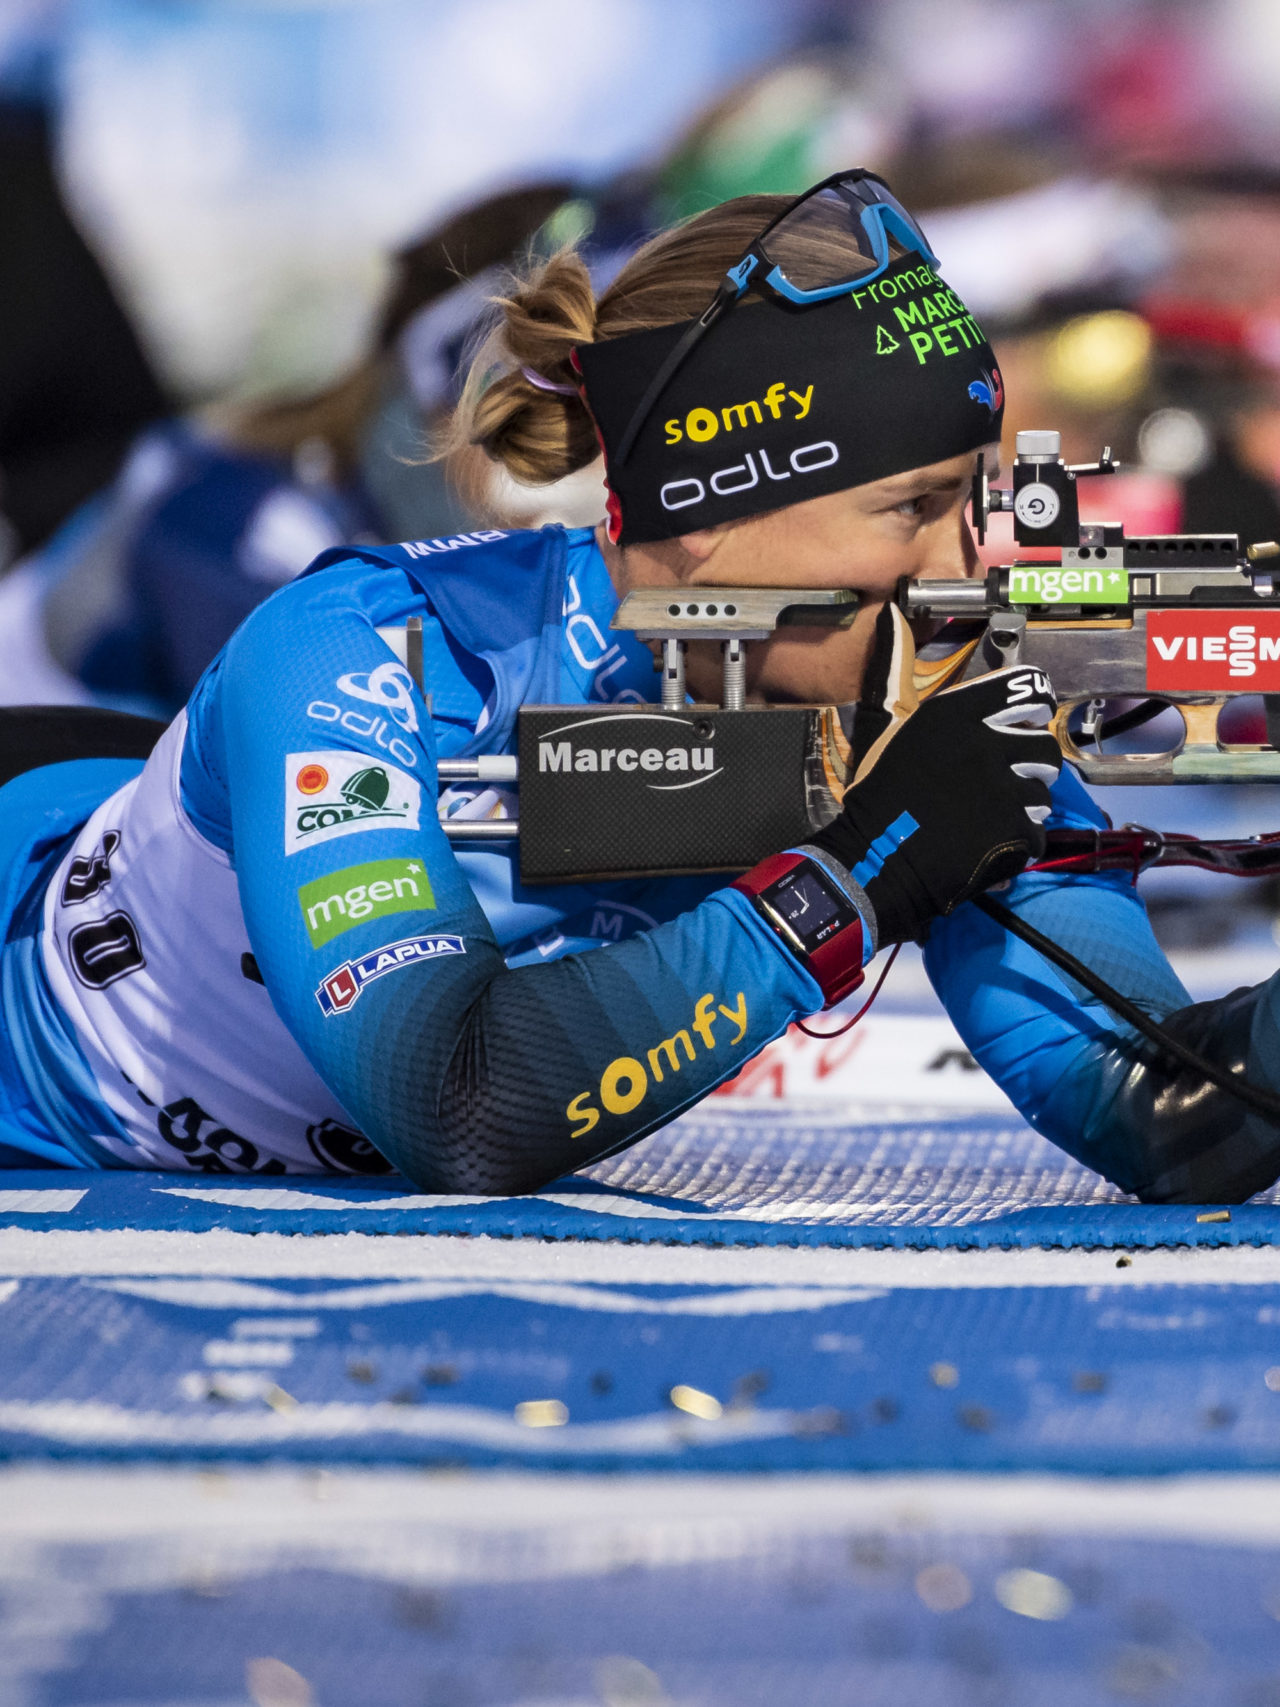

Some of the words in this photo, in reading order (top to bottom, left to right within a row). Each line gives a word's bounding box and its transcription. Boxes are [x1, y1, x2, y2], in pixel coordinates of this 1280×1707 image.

[660, 440, 839, 511] odlo
[399, 529, 511, 560] BMW
[1009, 570, 1104, 602] mgen
[306, 700, 418, 768] odlo
[538, 741, 715, 773] Marceau
[306, 876, 420, 930] mgen
[356, 939, 458, 980] LAPUA
